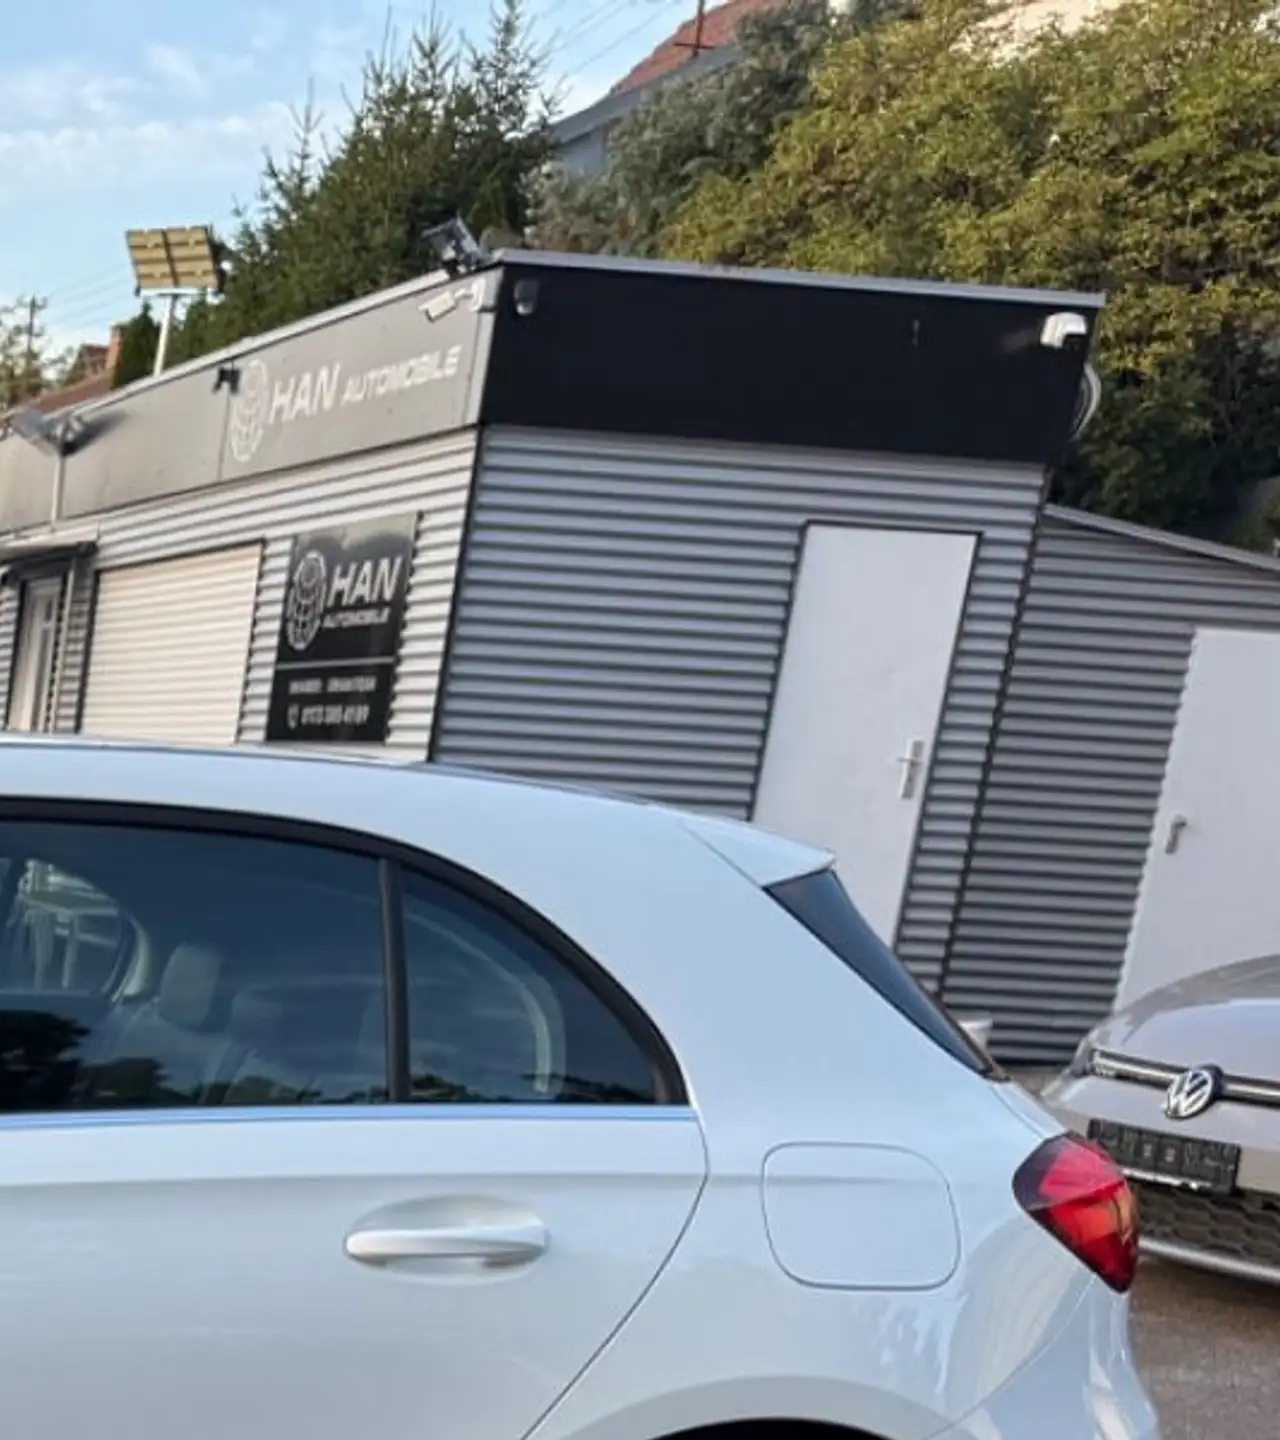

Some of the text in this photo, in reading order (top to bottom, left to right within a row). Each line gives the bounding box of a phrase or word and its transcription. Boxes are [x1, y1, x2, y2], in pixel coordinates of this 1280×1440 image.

[269, 344, 462, 424] HAN AUTOMOBILE
[326, 555, 403, 607] HAN
